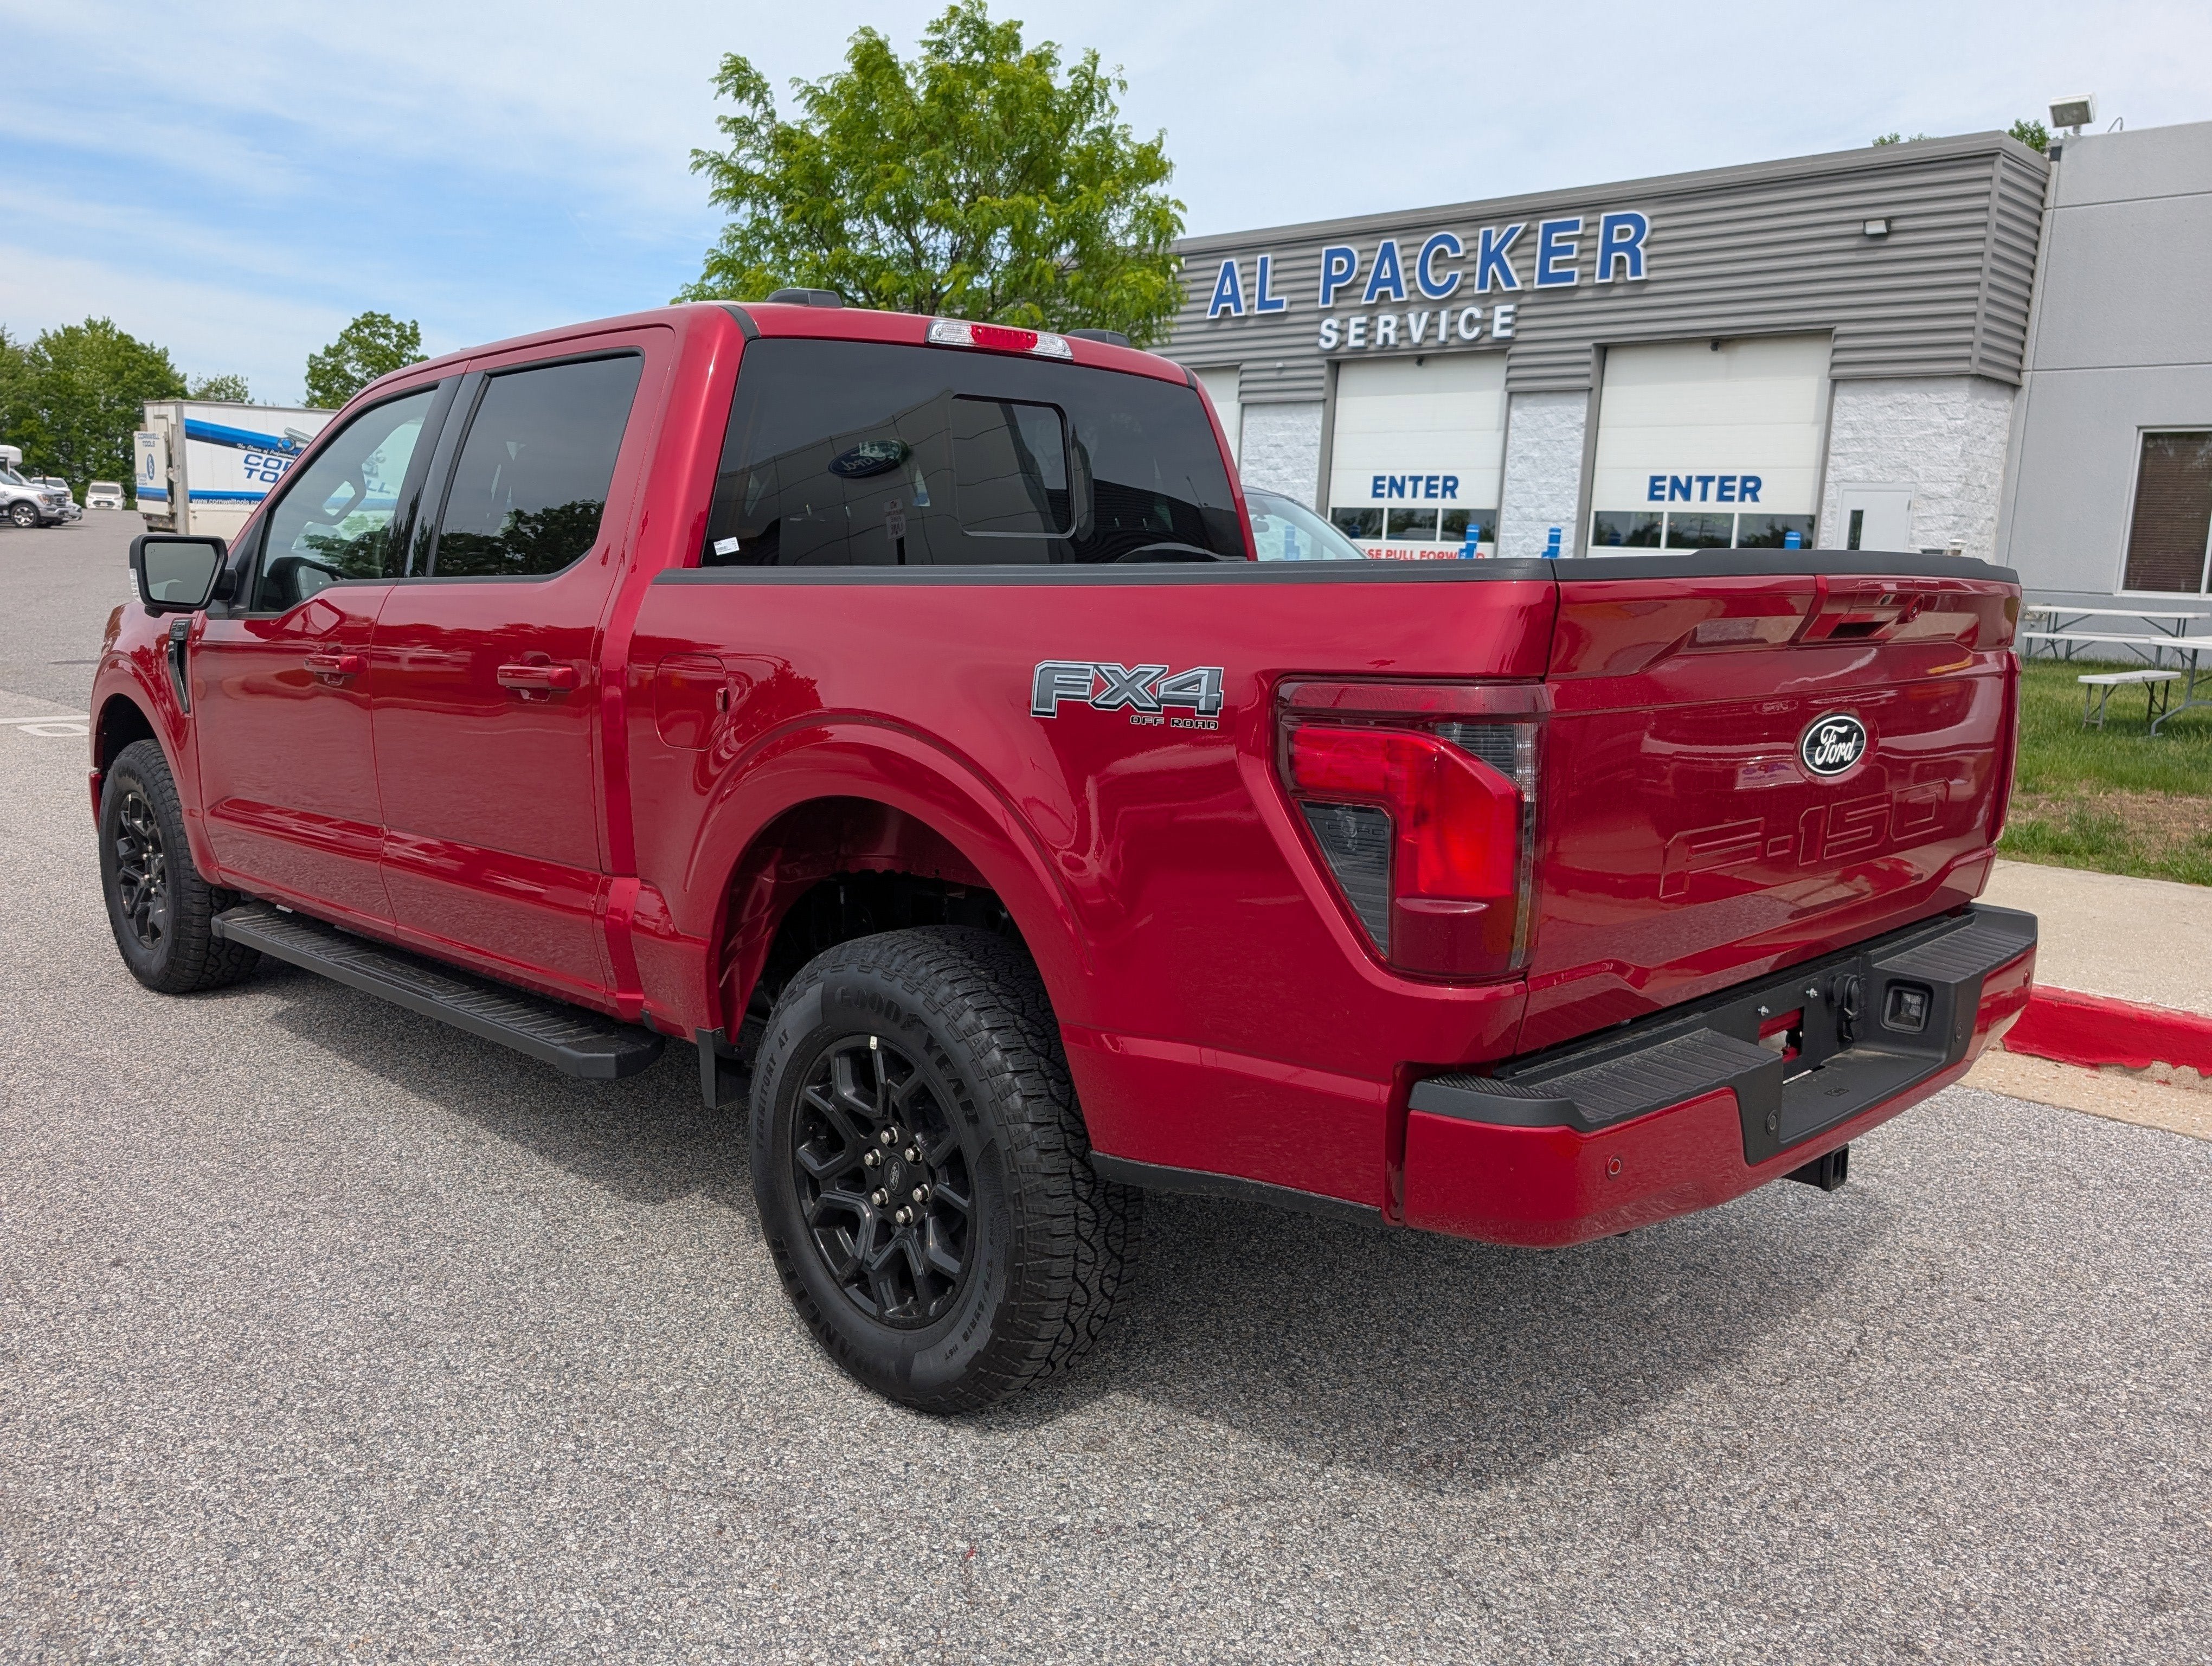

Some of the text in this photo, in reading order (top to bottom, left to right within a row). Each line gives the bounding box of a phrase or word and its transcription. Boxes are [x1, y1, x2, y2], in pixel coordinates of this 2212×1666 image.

[1206, 210, 1650, 319] AL PACKER
[1318, 304, 1516, 350] SERVICE
[1371, 475, 1459, 500] ENTER
[1648, 475, 1763, 503] ENTER
[1363, 548, 1382, 559] SE
[1385, 549, 1416, 560] PULL
[1419, 551, 1486, 560] FORWD
[1031, 660, 1224, 719] FX4
[1130, 715, 1219, 730] OFF ROAD
[1659, 778, 1951, 899] F-150
[756, 1028, 789, 1150] TERRITORY AT
